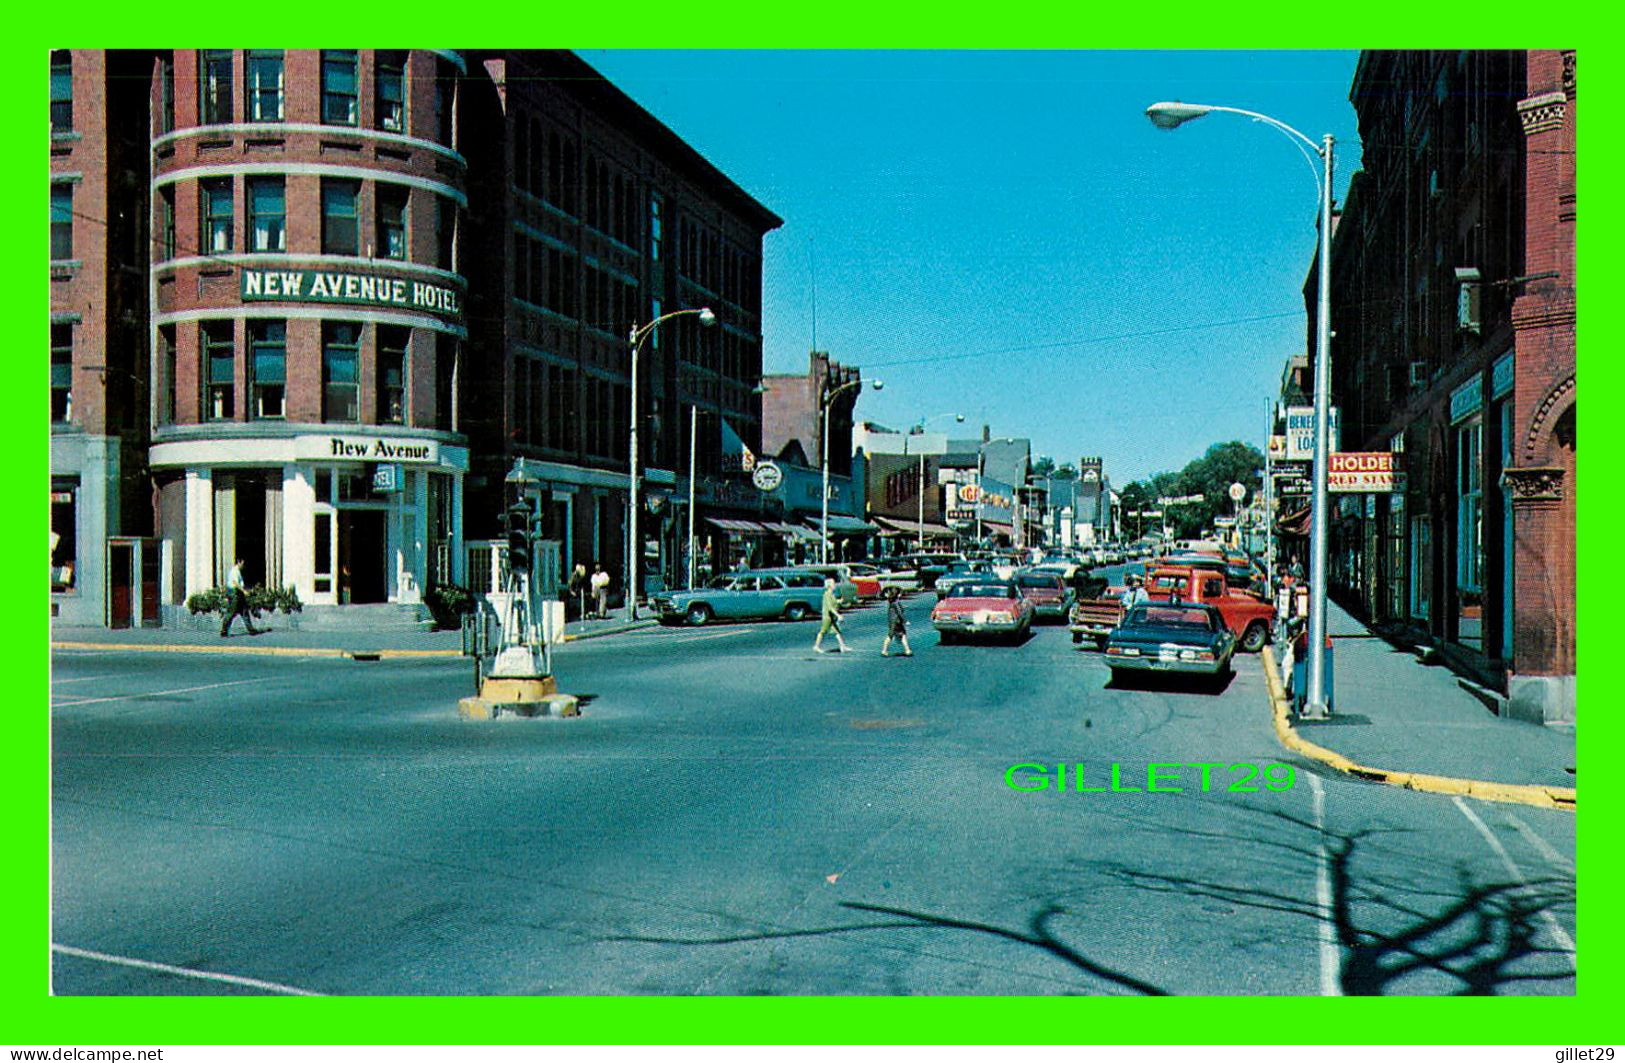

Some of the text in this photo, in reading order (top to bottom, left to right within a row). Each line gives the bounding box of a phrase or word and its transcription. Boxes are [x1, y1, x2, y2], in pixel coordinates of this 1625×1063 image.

[246, 271, 460, 313] NEW AVENUE HOTEL
[331, 438, 430, 459] New Avenue
